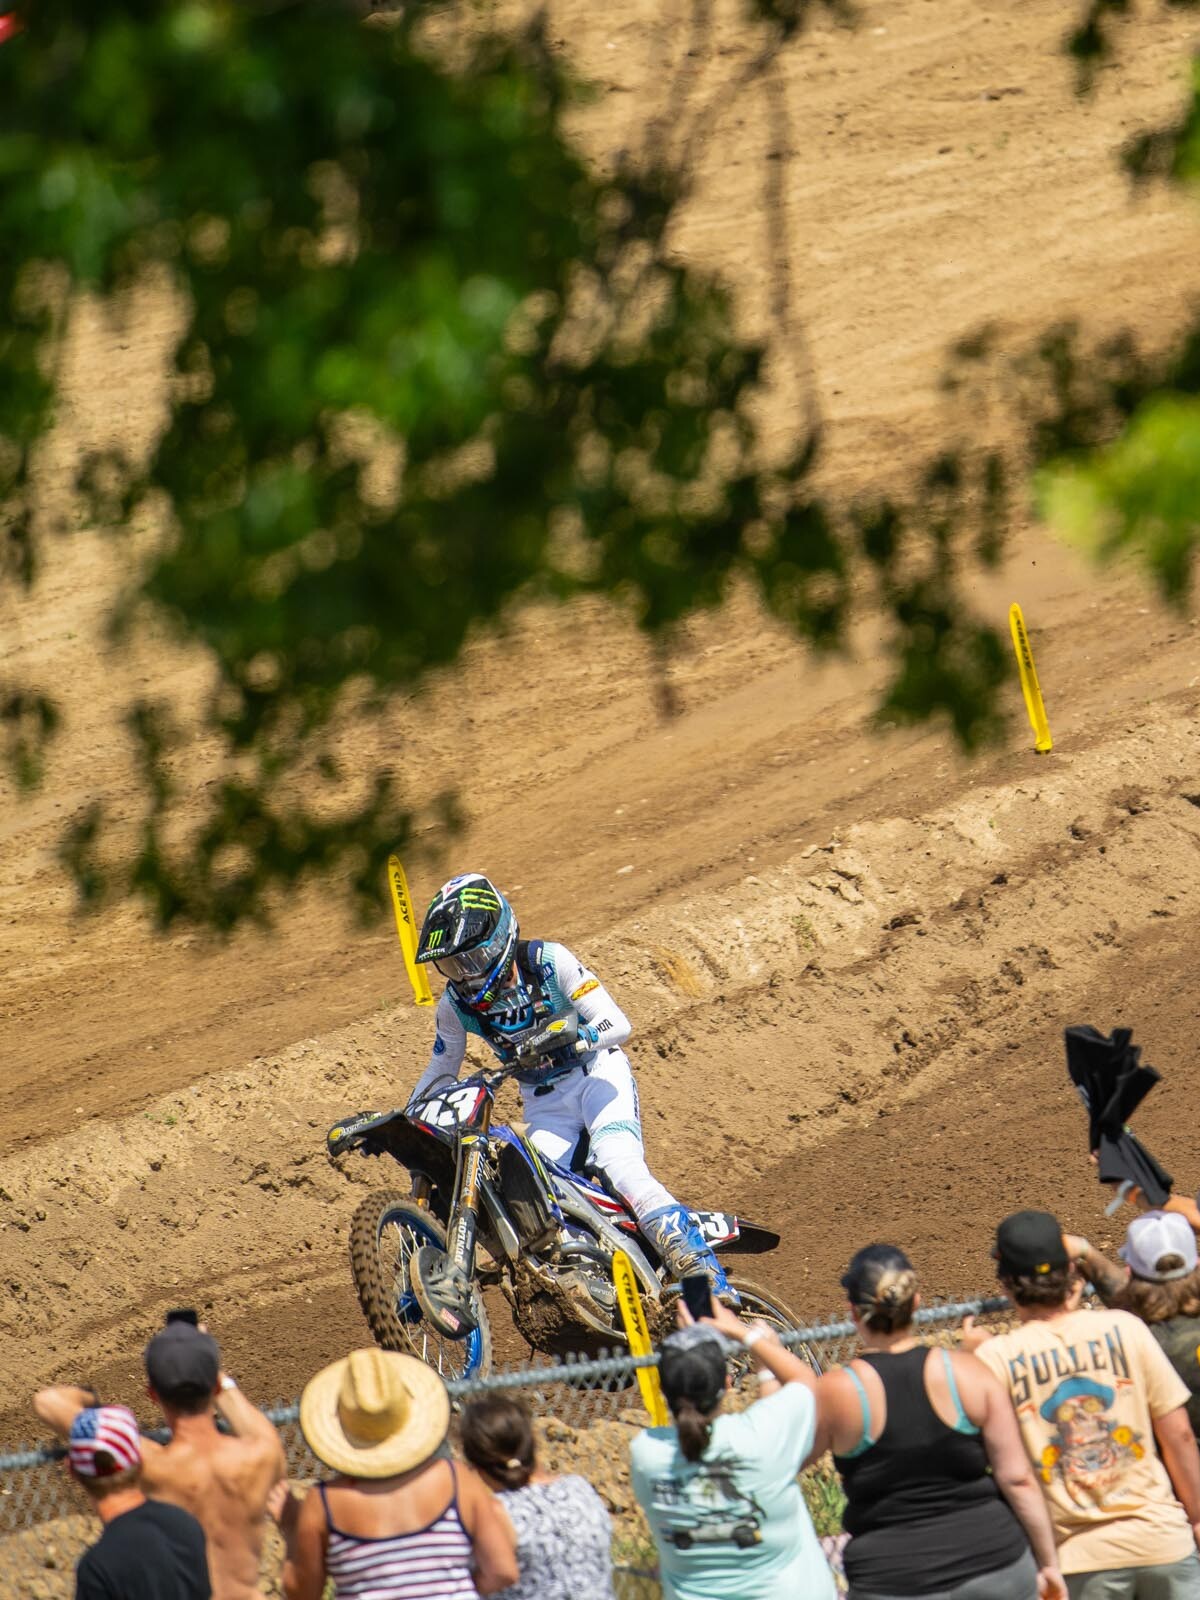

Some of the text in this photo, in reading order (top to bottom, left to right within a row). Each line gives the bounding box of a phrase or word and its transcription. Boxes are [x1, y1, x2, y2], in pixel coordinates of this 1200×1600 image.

[393, 871, 411, 925] ACERBIS
[454, 1217, 467, 1264] DUNLOP
[621, 1272, 644, 1337] ACERBIS
[1009, 1324, 1130, 1406] SULLEN
